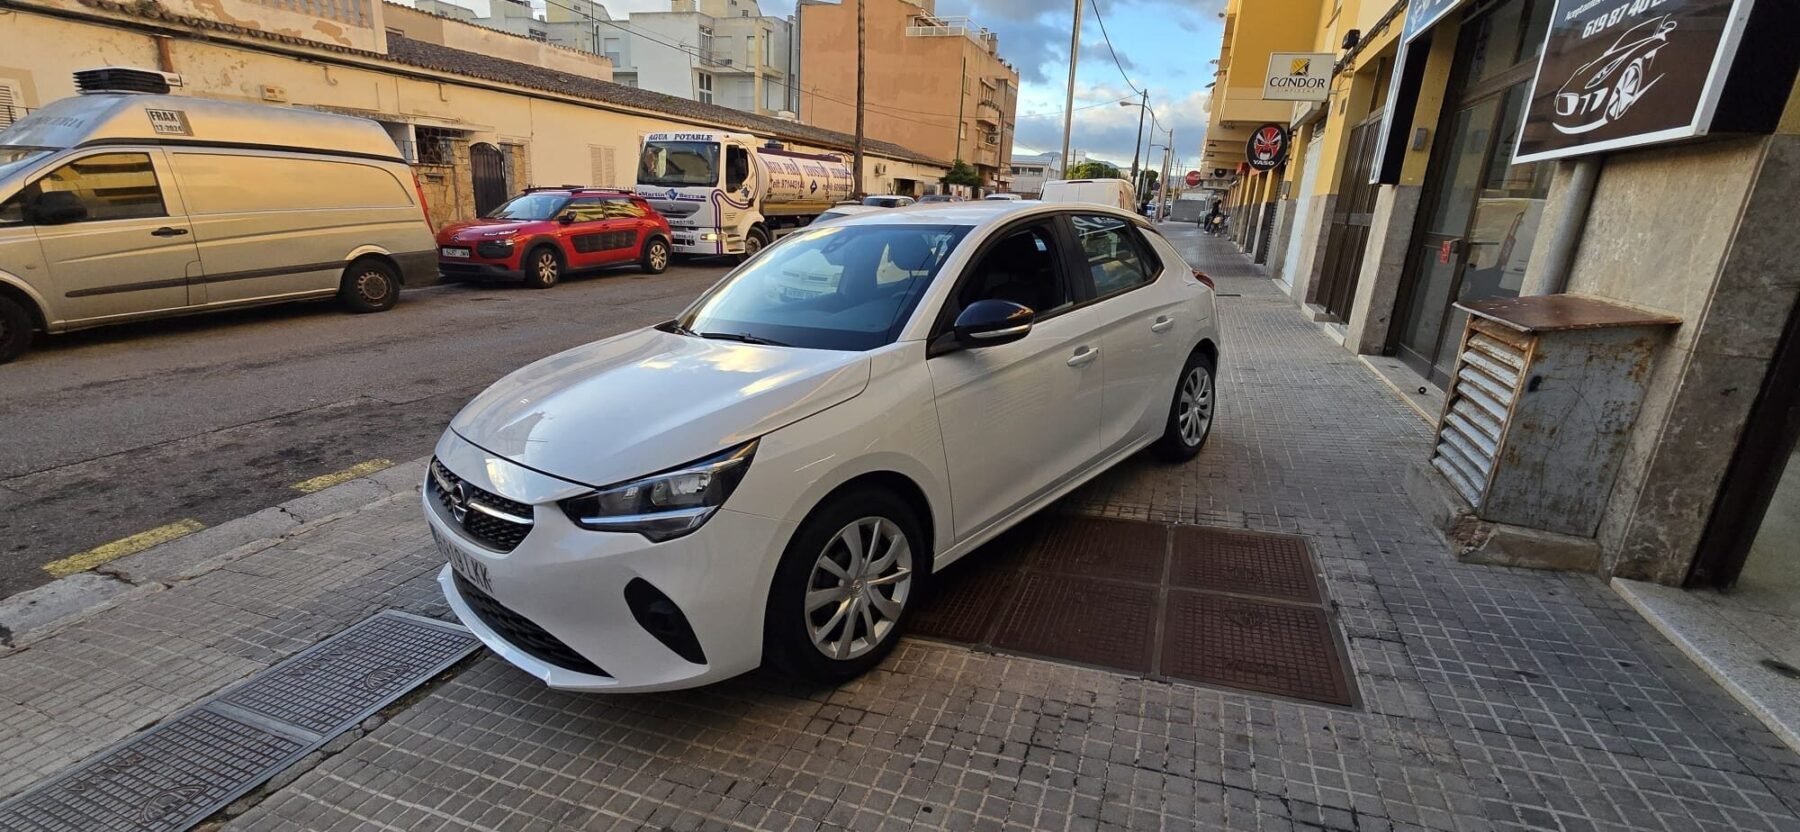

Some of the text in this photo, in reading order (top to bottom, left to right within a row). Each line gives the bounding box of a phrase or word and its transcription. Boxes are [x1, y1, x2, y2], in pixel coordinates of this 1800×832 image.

[1582, 0, 1650, 39] 619 87 40
[150, 111, 177, 122] FRAX
[463, 553, 494, 594] LKK
